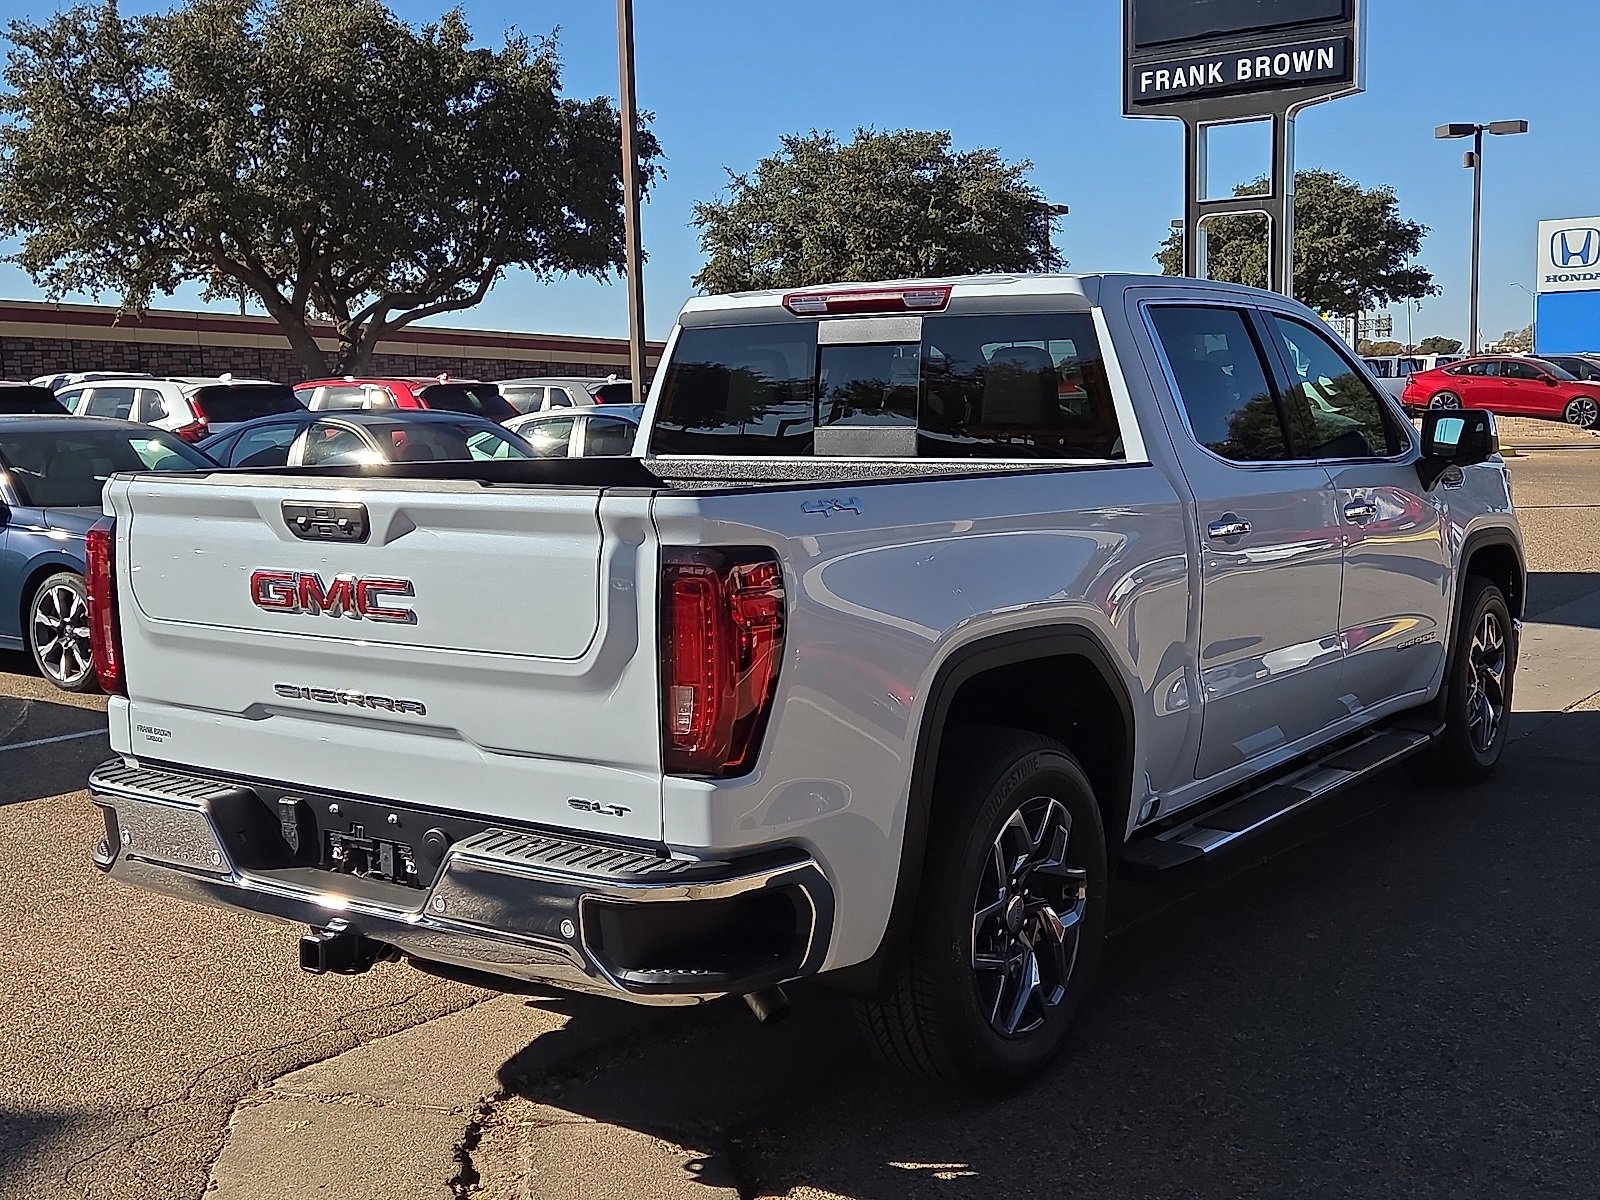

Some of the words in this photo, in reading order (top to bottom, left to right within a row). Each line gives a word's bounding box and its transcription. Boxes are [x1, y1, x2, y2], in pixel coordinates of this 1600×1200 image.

[1140, 61, 1224, 93] FRANK
[1236, 46, 1335, 81] BROWN
[250, 569, 418, 626] GMC
[274, 683, 427, 716] SIERRA
[153, 727, 172, 738] BROWN
[567, 798, 632, 817] SLT
